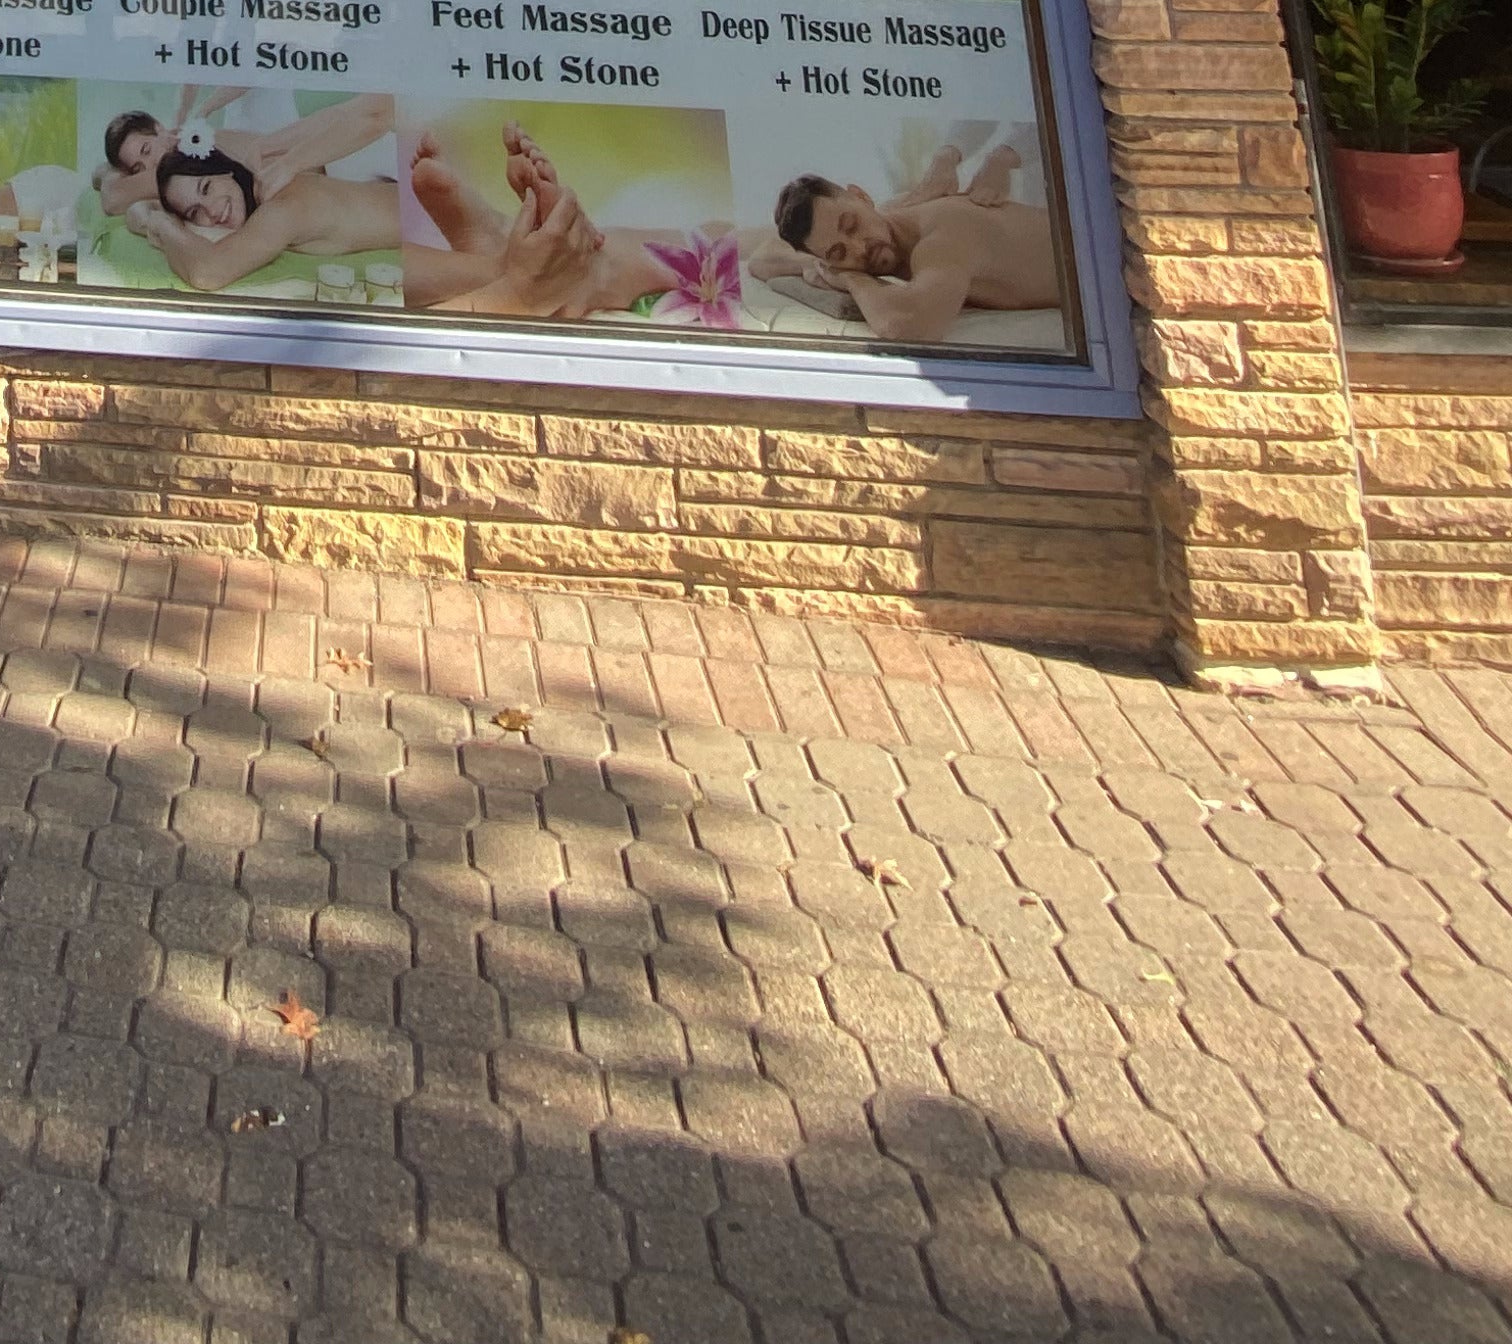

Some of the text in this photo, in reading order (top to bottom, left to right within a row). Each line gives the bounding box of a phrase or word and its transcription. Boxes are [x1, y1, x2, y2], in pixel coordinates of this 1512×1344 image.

[431, 0, 672, 41] Feet Massage
[701, 10, 1007, 54] Deep Tissue Massage
[187, 39, 241, 68] Hot
[255, 42, 349, 73] Stone
[485, 52, 544, 82] Hot
[560, 55, 660, 88] Stone
[802, 65, 850, 95] Hot
[862, 67, 942, 99] Stone
